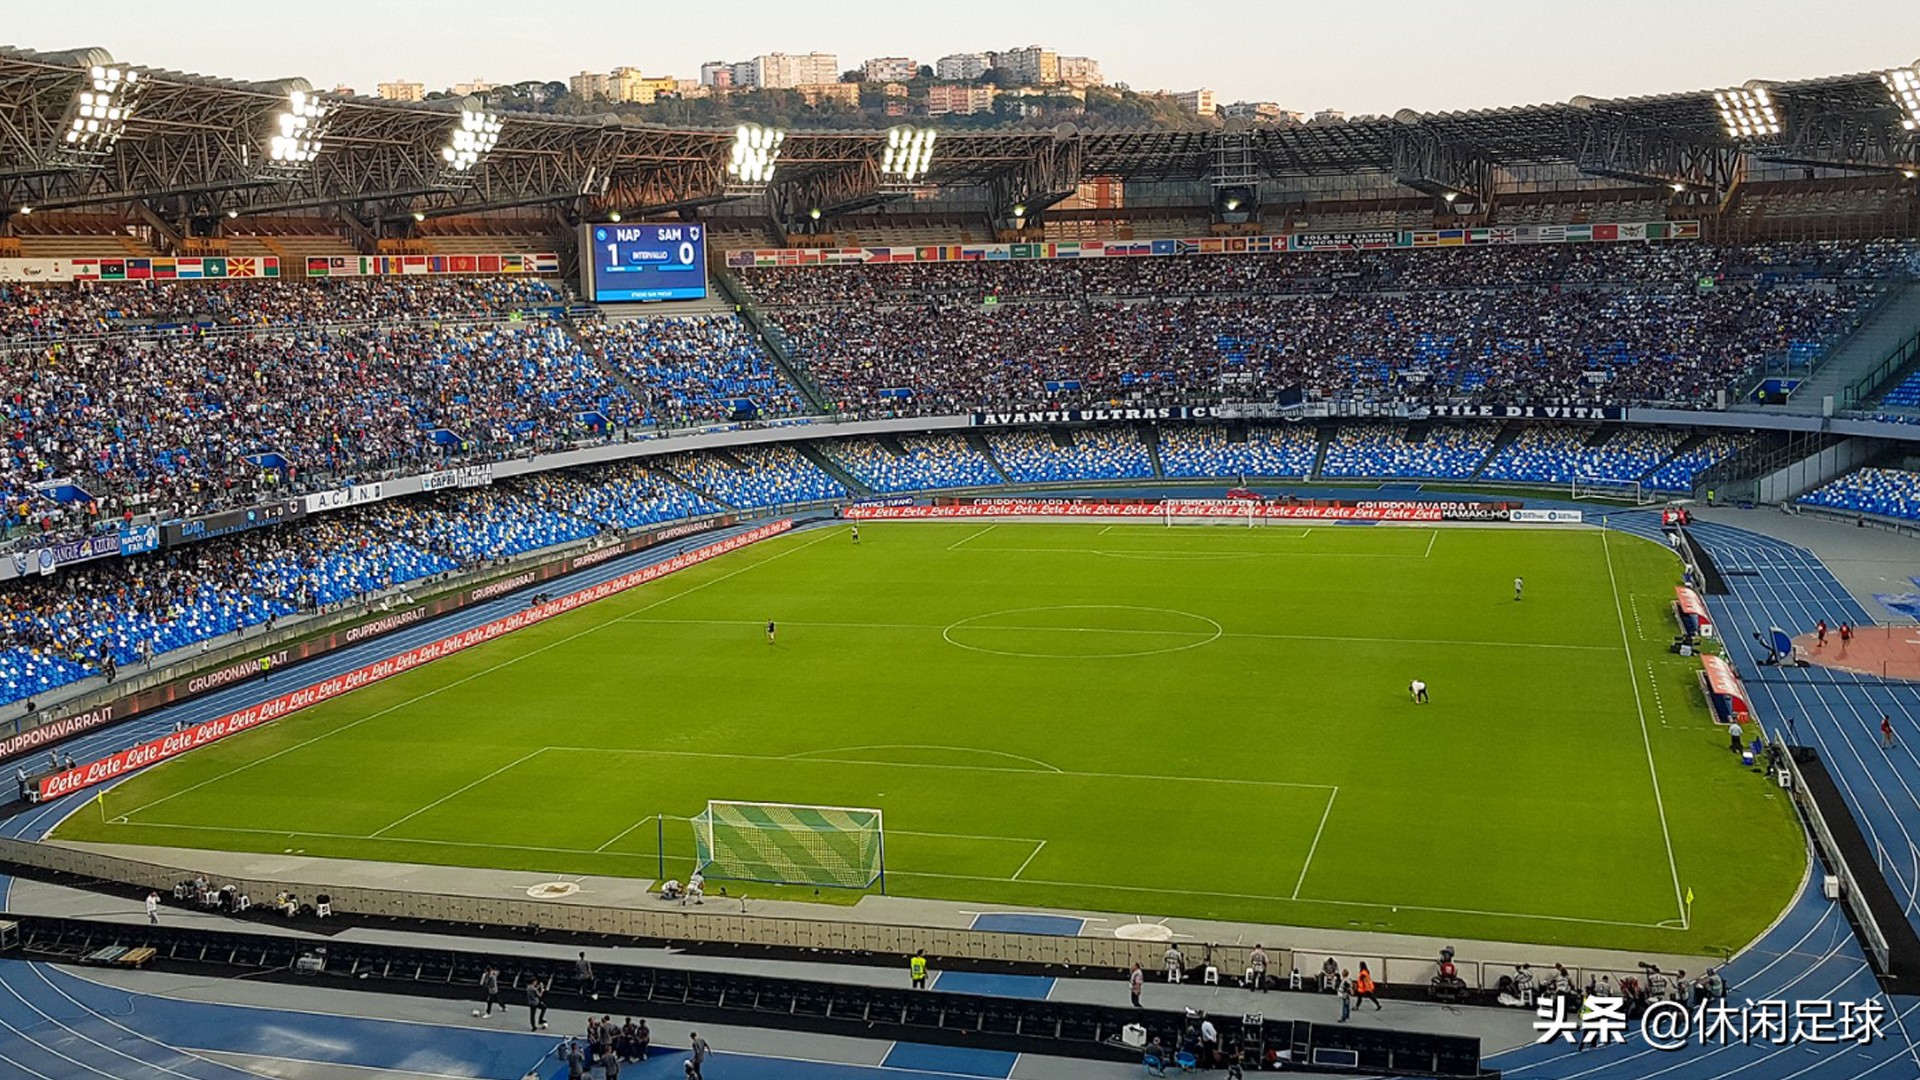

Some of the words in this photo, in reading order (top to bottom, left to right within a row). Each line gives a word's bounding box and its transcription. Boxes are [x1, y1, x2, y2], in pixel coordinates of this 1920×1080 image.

[617, 229, 641, 241] NAP
[658, 228, 682, 240] SAM
[607, 243, 619, 266] 1
[679, 242, 695, 265] 0
[632, 251, 668, 260] INTERVALLO
[984, 411, 1070, 425] AVANTI
[1081, 407, 1170, 421] ULTRAS
[1192, 406, 1221, 417] CU
[1506, 406, 1535, 417] DI
[1544, 407, 1605, 419] VITA
[459, 463, 492, 477] APULIA
[431, 475, 456, 489] CAPRI
[887, 498, 913, 507] TUFANO
[847, 508, 871, 517] Lete
[874, 508, 899, 517] Lete
[900, 507, 926, 517] Lete
[928, 507, 955, 516] Lete
[955, 506, 982, 515] Lete
[983, 505, 1010, 515] Lete
[1011, 505, 1037, 514] Lete
[1038, 505, 1064, 514] Lete
[1065, 505, 1092, 514] Lete
[1093, 505, 1120, 514] Lete
[1120, 505, 1148, 514] Lete
[1177, 505, 1204, 515] Lete
[1205, 505, 1232, 515] Lete
[1234, 506, 1260, 516] Lete
[1263, 506, 1291, 516] Lete
[1293, 507, 1320, 517] Lete
[1321, 507, 1350, 518] Lete
[1350, 509, 1380, 518] Lete
[1381, 509, 1410, 519] Lete
[1411, 509, 1441, 519] Lete
[1442, 510, 1510, 518] HAMAKI-HO
[122, 535, 147, 545] NAPOLI
[53, 544, 79, 563] SANGUE
[128, 543, 144, 553] FAN
[0, 706, 113, 757] RUPPONAVARRA.IT
[346, 607, 426, 641] GRUPPONAVARRA.IT
[472, 572, 536, 600] GRUPPONAVARRA.IT
[573, 543, 627, 569] GRUPPONAVARRA.IT
[657, 520, 716, 541] GRUPPONAVARRA.IT
[43, 772, 82, 797] Lete
[84, 758, 121, 783] Lete
[122, 745, 157, 772] Lete
[158, 733, 192, 756] Lete
[193, 719, 224, 744] Lete
[226, 709, 256, 732] Lete
[257, 698, 286, 721] Lete
[287, 688, 315, 711] Lete
[316, 679, 342, 699] Lete
[343, 670, 369, 690] Lete
[369, 660, 394, 681] Lete
[394, 651, 417, 671] Lete
[418, 643, 441, 663] Lete
[442, 636, 463, 655] Lete
[463, 628, 484, 647] Lete
[484, 621, 504, 638] Lete
[504, 614, 523, 631] Lete
[524, 608, 542, 624] Lete
[542, 602, 560, 617] Lete
[560, 596, 577, 611] Lete
[578, 590, 595, 604] Lete
[595, 584, 611, 598] Lete
